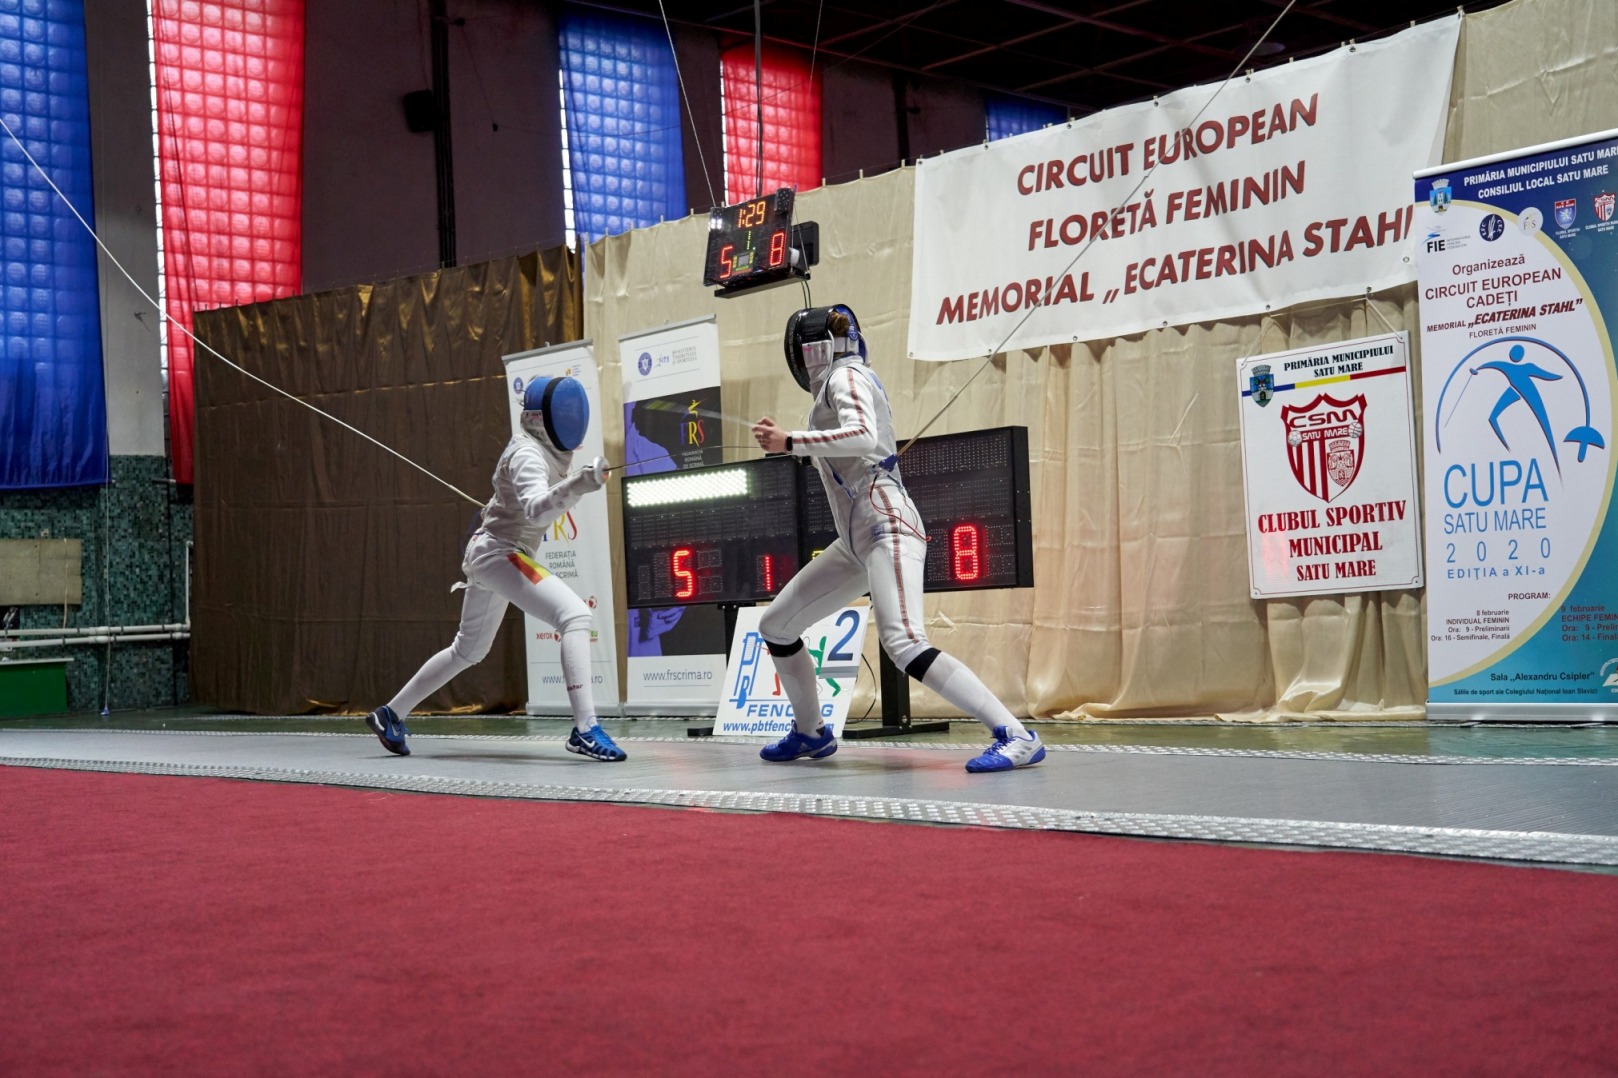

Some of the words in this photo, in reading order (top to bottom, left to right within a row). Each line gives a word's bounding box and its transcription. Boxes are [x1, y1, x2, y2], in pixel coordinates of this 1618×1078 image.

[1017, 143, 1134, 197] CIRCUIT
[1143, 93, 1319, 171] EUROPEAN
[1464, 169, 1505, 187] PRIMĂRIA
[1507, 156, 1569, 178] MUNICIPIULUI
[1571, 150, 1595, 165] SATU
[1597, 145, 1618, 160] MAR
[1478, 182, 1524, 199] CONSILIUL
[1526, 176, 1555, 190] LOCAL
[1556, 171, 1581, 184] SATU
[1583, 164, 1609, 180] MARE
[738, 201, 766, 228] 1:29
[1028, 189, 1157, 251] FLORETĂ
[1166, 160, 1307, 224] FEMININ
[769, 232, 785, 267] 8
[1427, 240, 1446, 253] FIE
[720, 245, 733, 279] 5
[1452, 254, 1525, 276] Organizează
[1425, 281, 1478, 301] CIRCUIT
[1482, 267, 1561, 291] EUROPEAN
[936, 271, 1095, 326] MEMORIAL
[1427, 320, 1466, 333] MEMORIAL
[1506, 323, 1537, 334] FEMININ
[1284, 355, 1330, 371] PRIMĂRIA
[1332, 345, 1394, 364] MUNICIPIULUI
[1314, 366, 1335, 378] SATU
[1338, 362, 1363, 374] MARE
[1289, 408, 1358, 429] CSM
[680, 419, 705, 447] FRS
[1302, 430, 1321, 441] SATU
[1324, 428, 1348, 438] MARE
[1443, 457, 1549, 509] CUPA
[1258, 509, 1321, 533] CLUBUL
[1326, 500, 1407, 527] SPORTIV
[1443, 511, 1488, 534] SATU
[1494, 507, 1547, 531] MARE
[953, 525, 978, 580] 8
[1288, 531, 1383, 558] MUNICIPAL
[672, 549, 693, 598] 5
[1296, 564, 1330, 582] SATU
[1335, 560, 1377, 579] MARE
[1502, 569, 1510, 577] a
[1508, 592, 1551, 600] PROGRAM:
[1561, 614, 1592, 622] ECHIPE
[1570, 604, 1605, 612] februarie
[536, 632, 552, 640] xerox
[827, 609, 860, 662] 2
[1562, 624, 1578, 632] Ora:
[1562, 634, 1578, 642] Ora:
[643, 669, 713, 681] www.frscrima.ro
[1490, 673, 1508, 681] Sala
[1479, 688, 1494, 696] sport
[1505, 688, 1535, 696] Colegiului
[747, 704, 834, 717] FENCG
